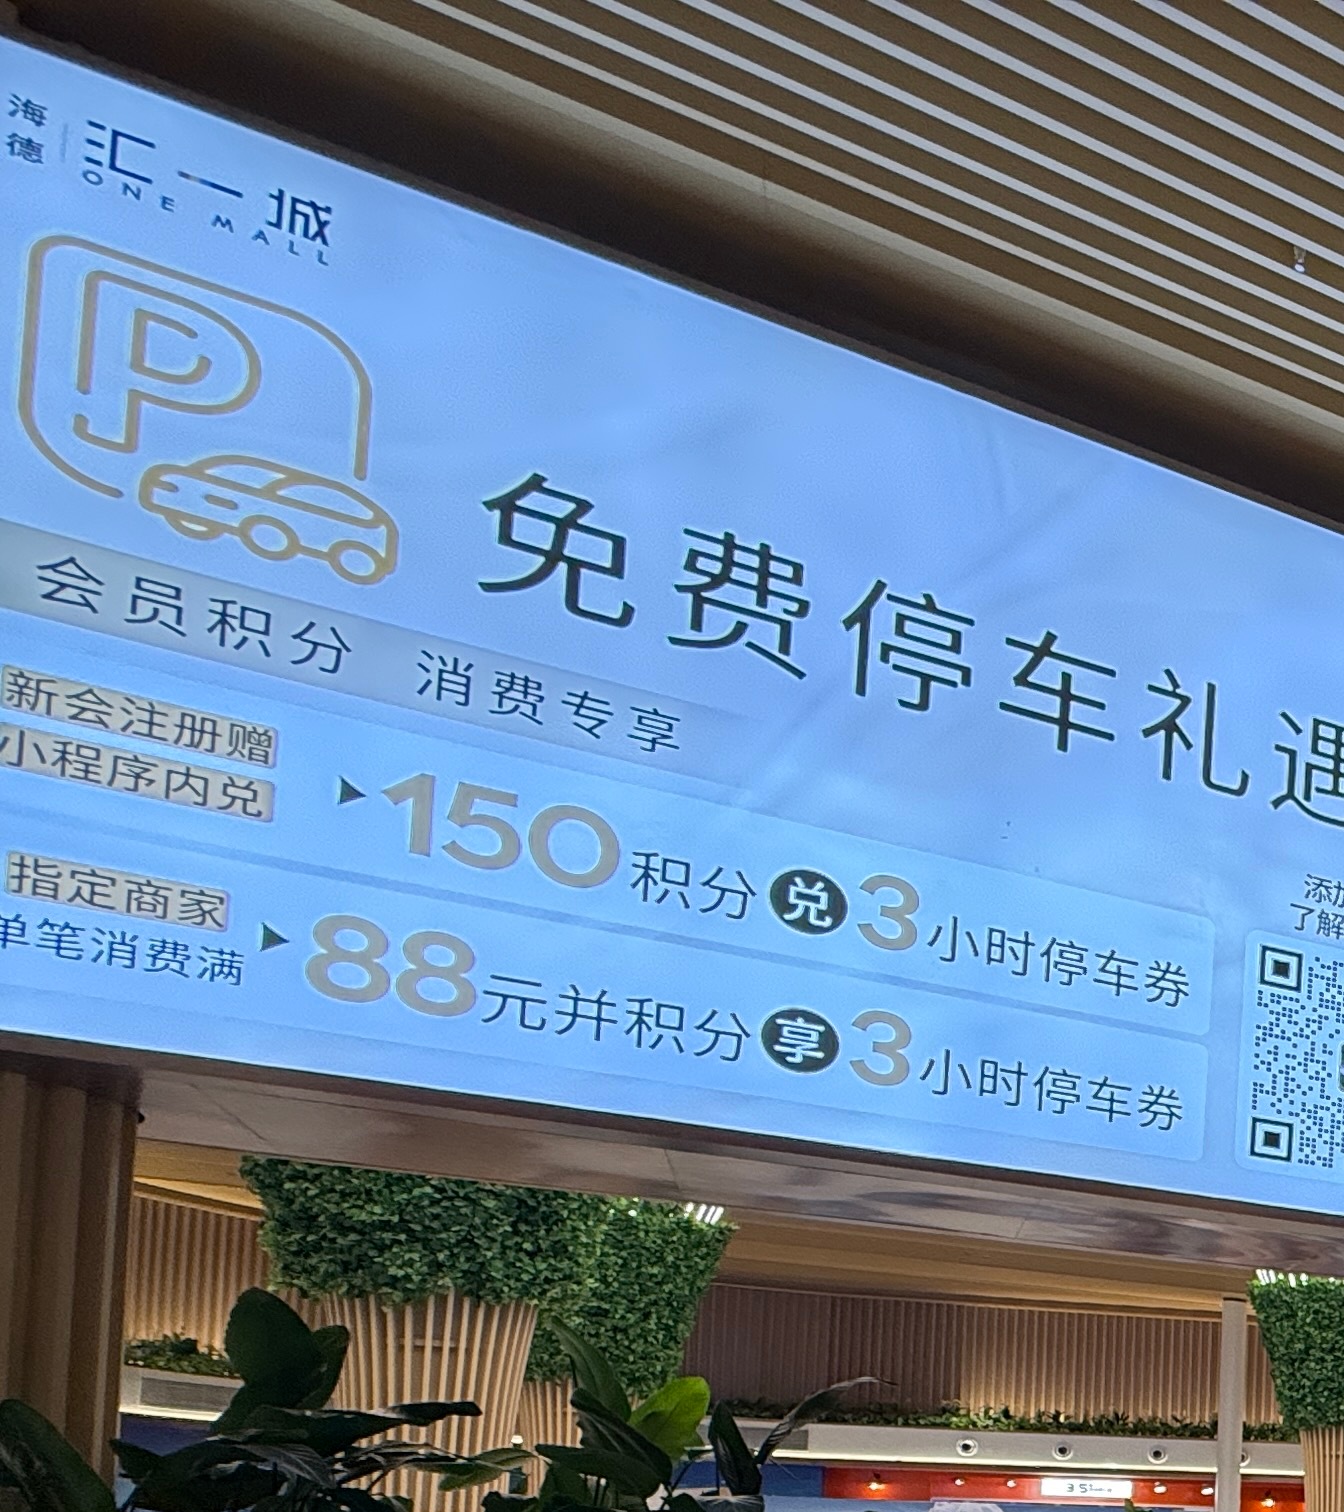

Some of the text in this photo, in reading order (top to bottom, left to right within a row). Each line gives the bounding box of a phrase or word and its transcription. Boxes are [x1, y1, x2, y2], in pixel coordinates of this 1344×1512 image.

[82, 170, 329, 266] ONE MALL
[84, 119, 333, 247] 汇一城
[36, 555, 682, 753] 会员积分 消费专享
[3, 669, 274, 767] 新会注册赠
[0, 726, 265, 818] 小程序内兑
[9, 854, 227, 929] 指定商家
[0, 913, 245, 986] 单笔消费满
